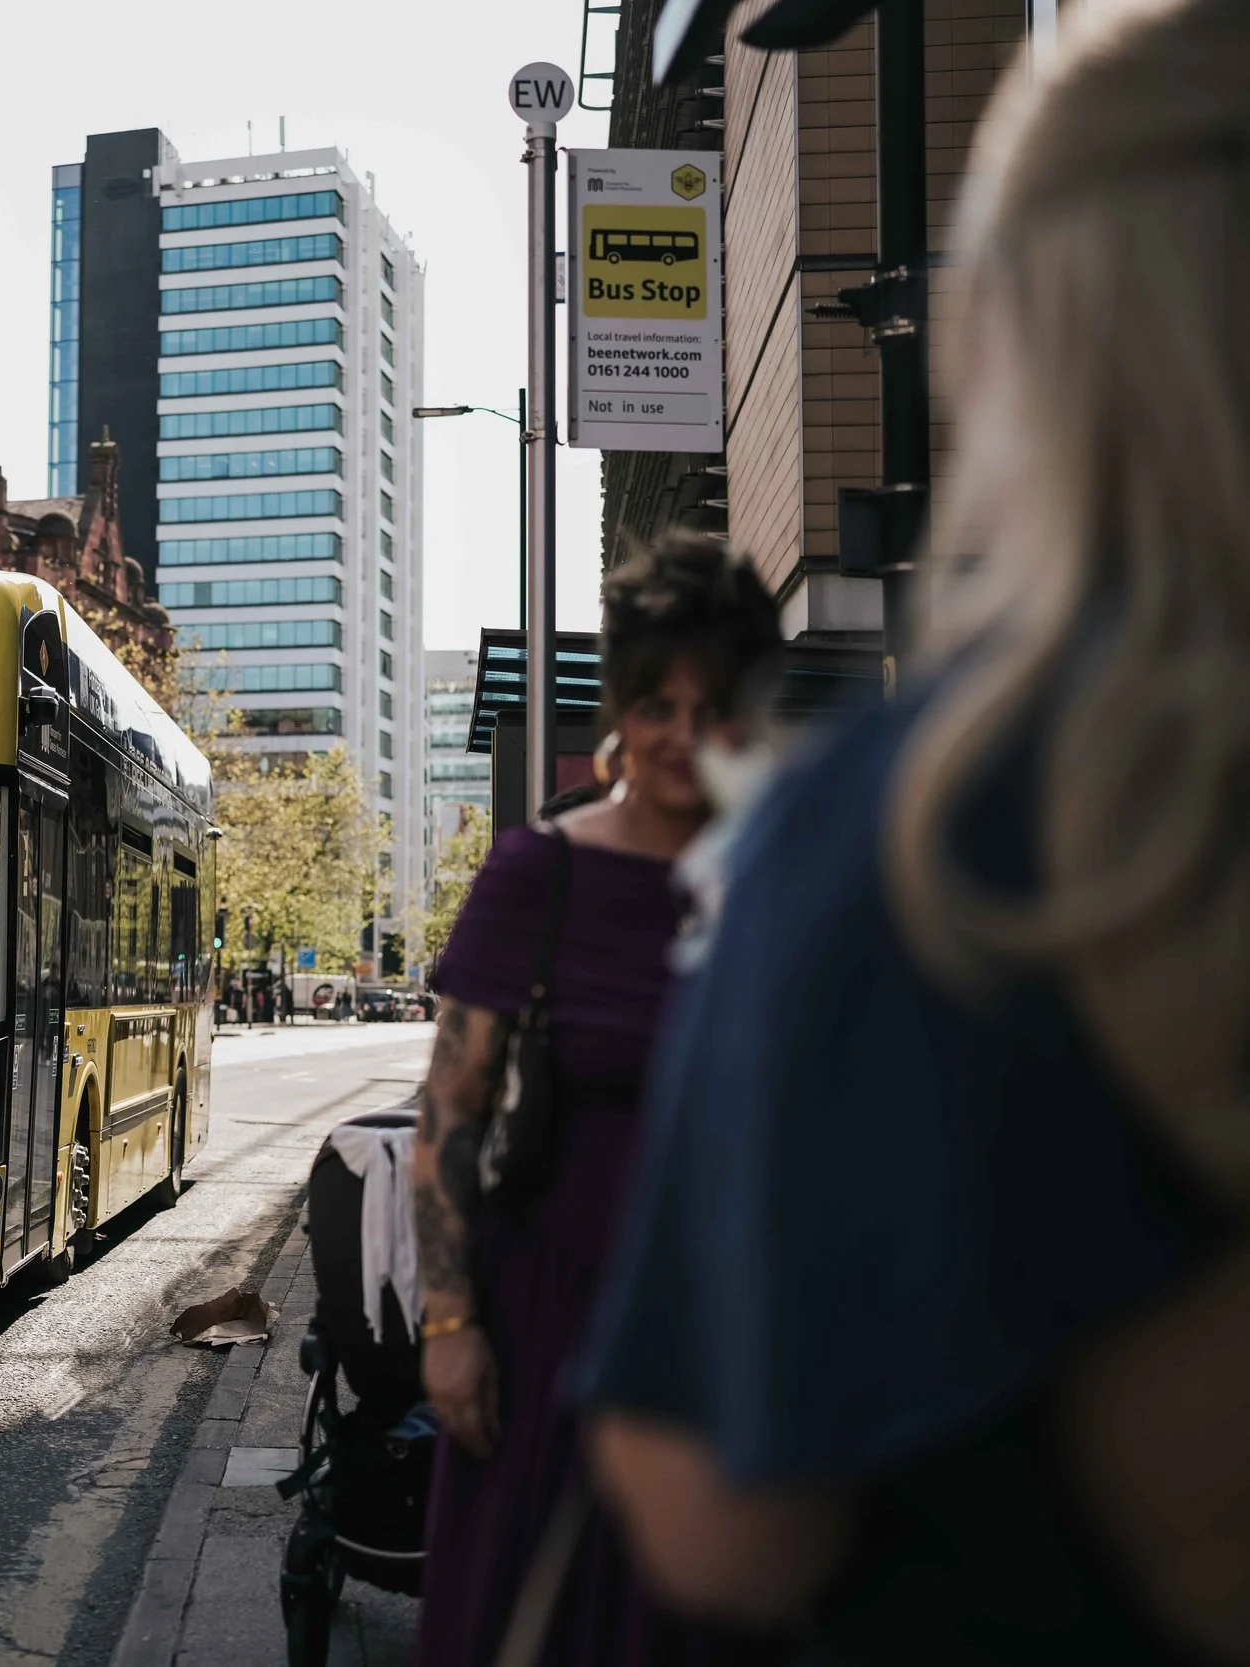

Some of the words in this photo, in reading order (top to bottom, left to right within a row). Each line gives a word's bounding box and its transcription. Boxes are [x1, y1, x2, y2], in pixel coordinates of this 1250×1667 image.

[515, 80, 566, 108] EW
[588, 278, 635, 300] Bus
[641, 279, 700, 309] Stop
[588, 332, 613, 341] Local
[614, 333, 641, 342] travel
[643, 334, 701, 344] information:
[588, 346, 702, 361] beenetwork.com
[588, 364, 620, 376] 0161
[623, 365, 650, 377] 244
[654, 366, 689, 378] 1000
[589, 400, 613, 413] Not
[623, 401, 635, 413] in
[641, 403, 664, 414] use
